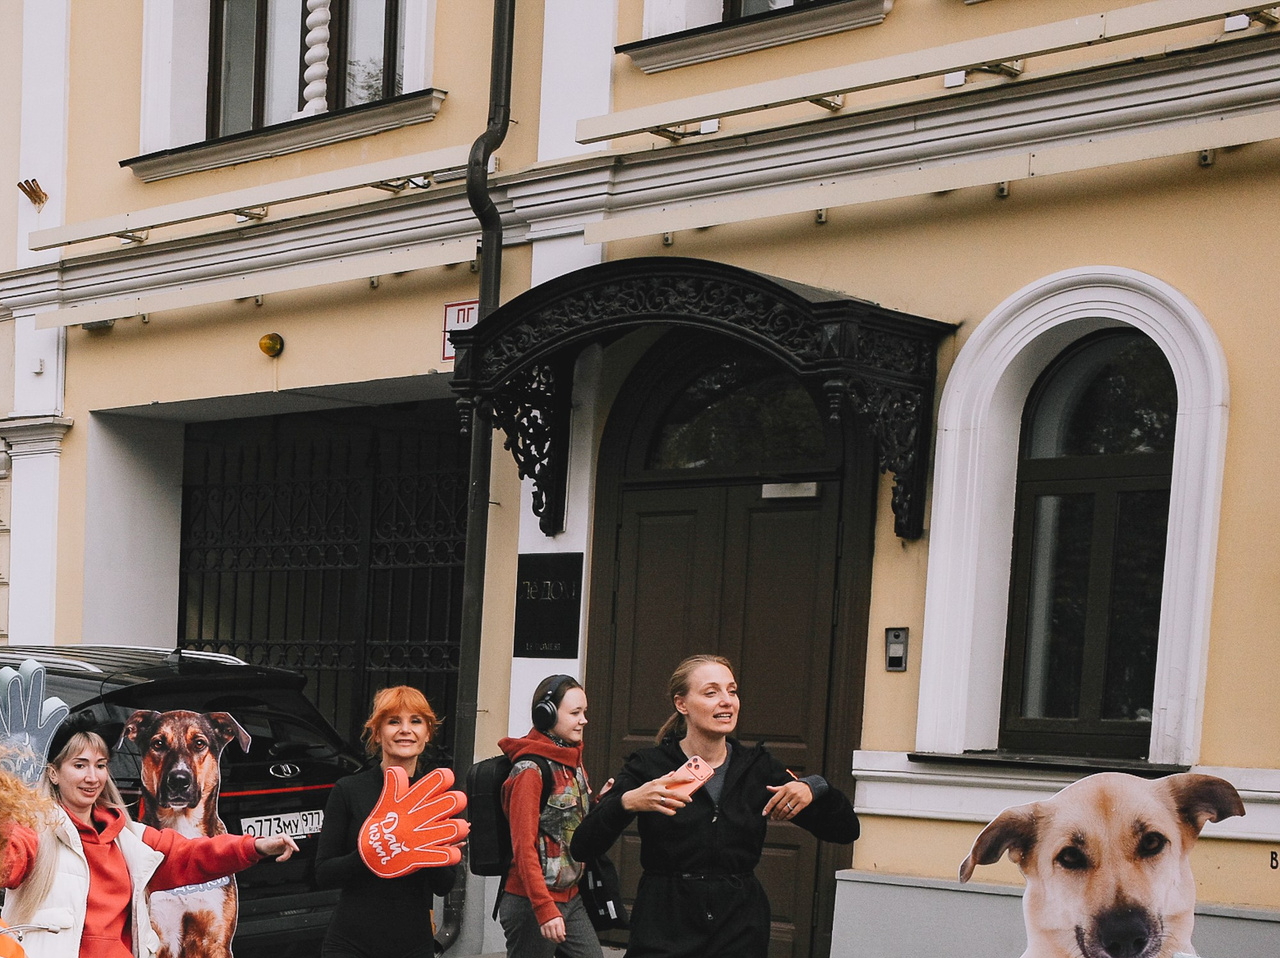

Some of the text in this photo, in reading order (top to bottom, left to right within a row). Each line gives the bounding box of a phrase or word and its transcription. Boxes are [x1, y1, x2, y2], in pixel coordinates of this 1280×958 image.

[302, 812, 320, 826] 977
[380, 812, 410, 858] Дай
[368, 822, 391, 865] пять
